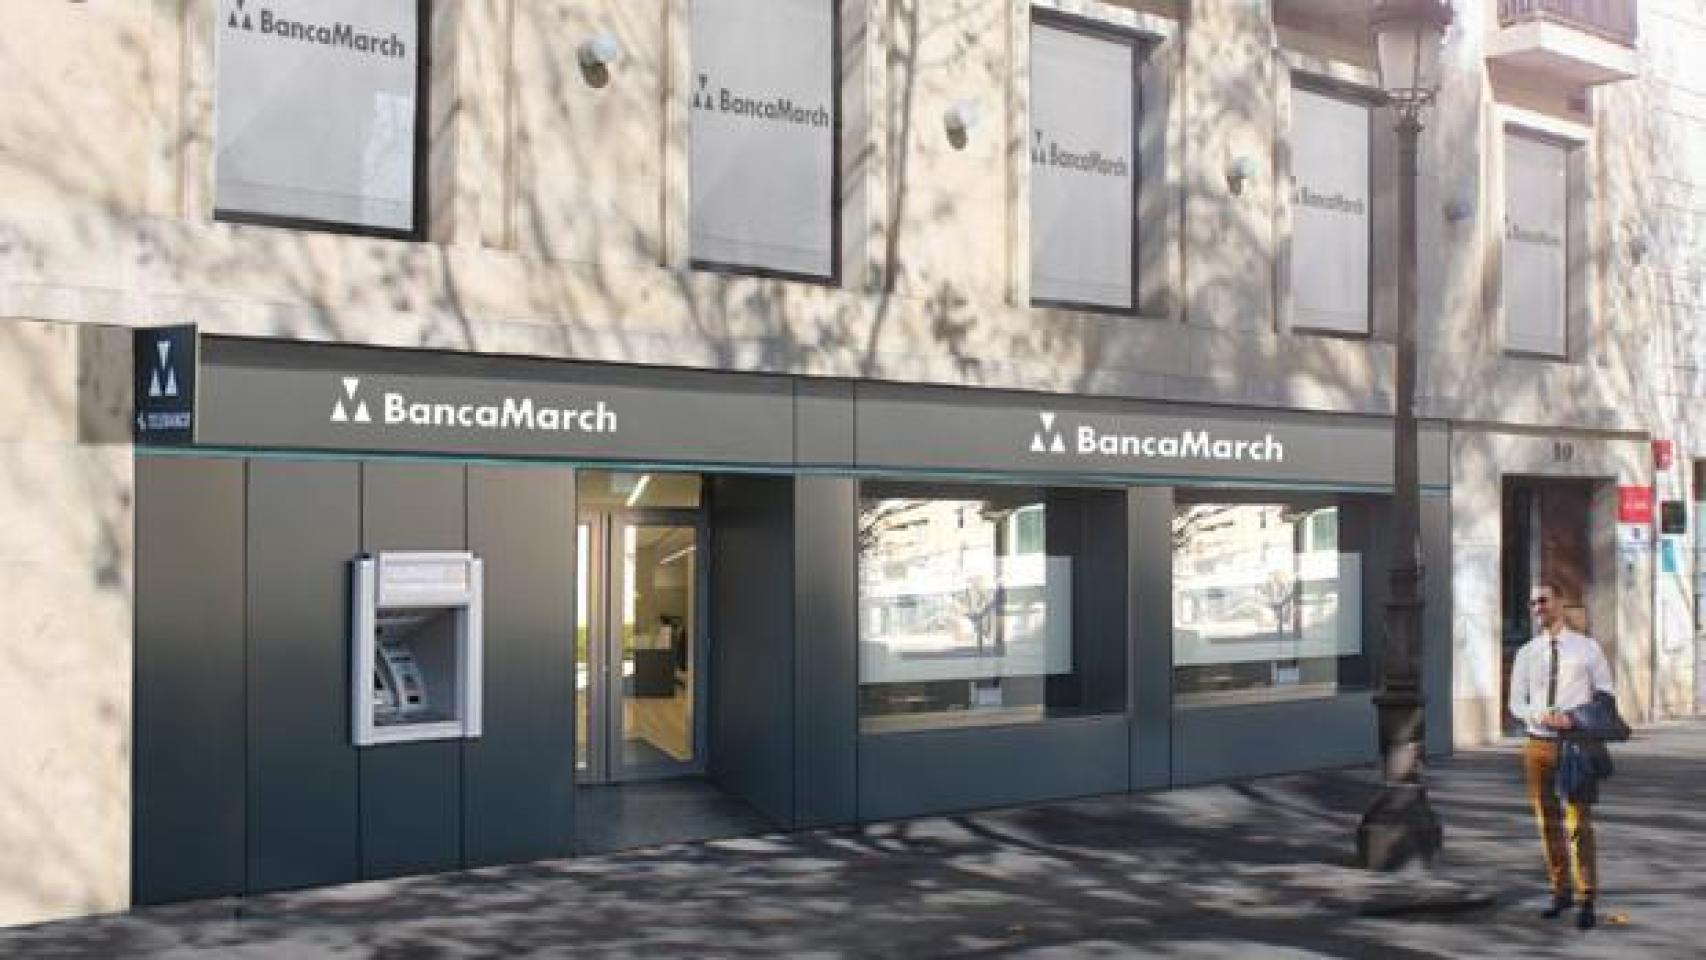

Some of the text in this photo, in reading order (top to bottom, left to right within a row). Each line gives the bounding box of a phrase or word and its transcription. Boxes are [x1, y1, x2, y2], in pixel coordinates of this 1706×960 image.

[260, 8, 405, 57] BancaMarch
[720, 87, 829, 127] BancaMarch
[384, 392, 617, 432] BancaMarch
[1077, 425, 1284, 462] BancaMarch
